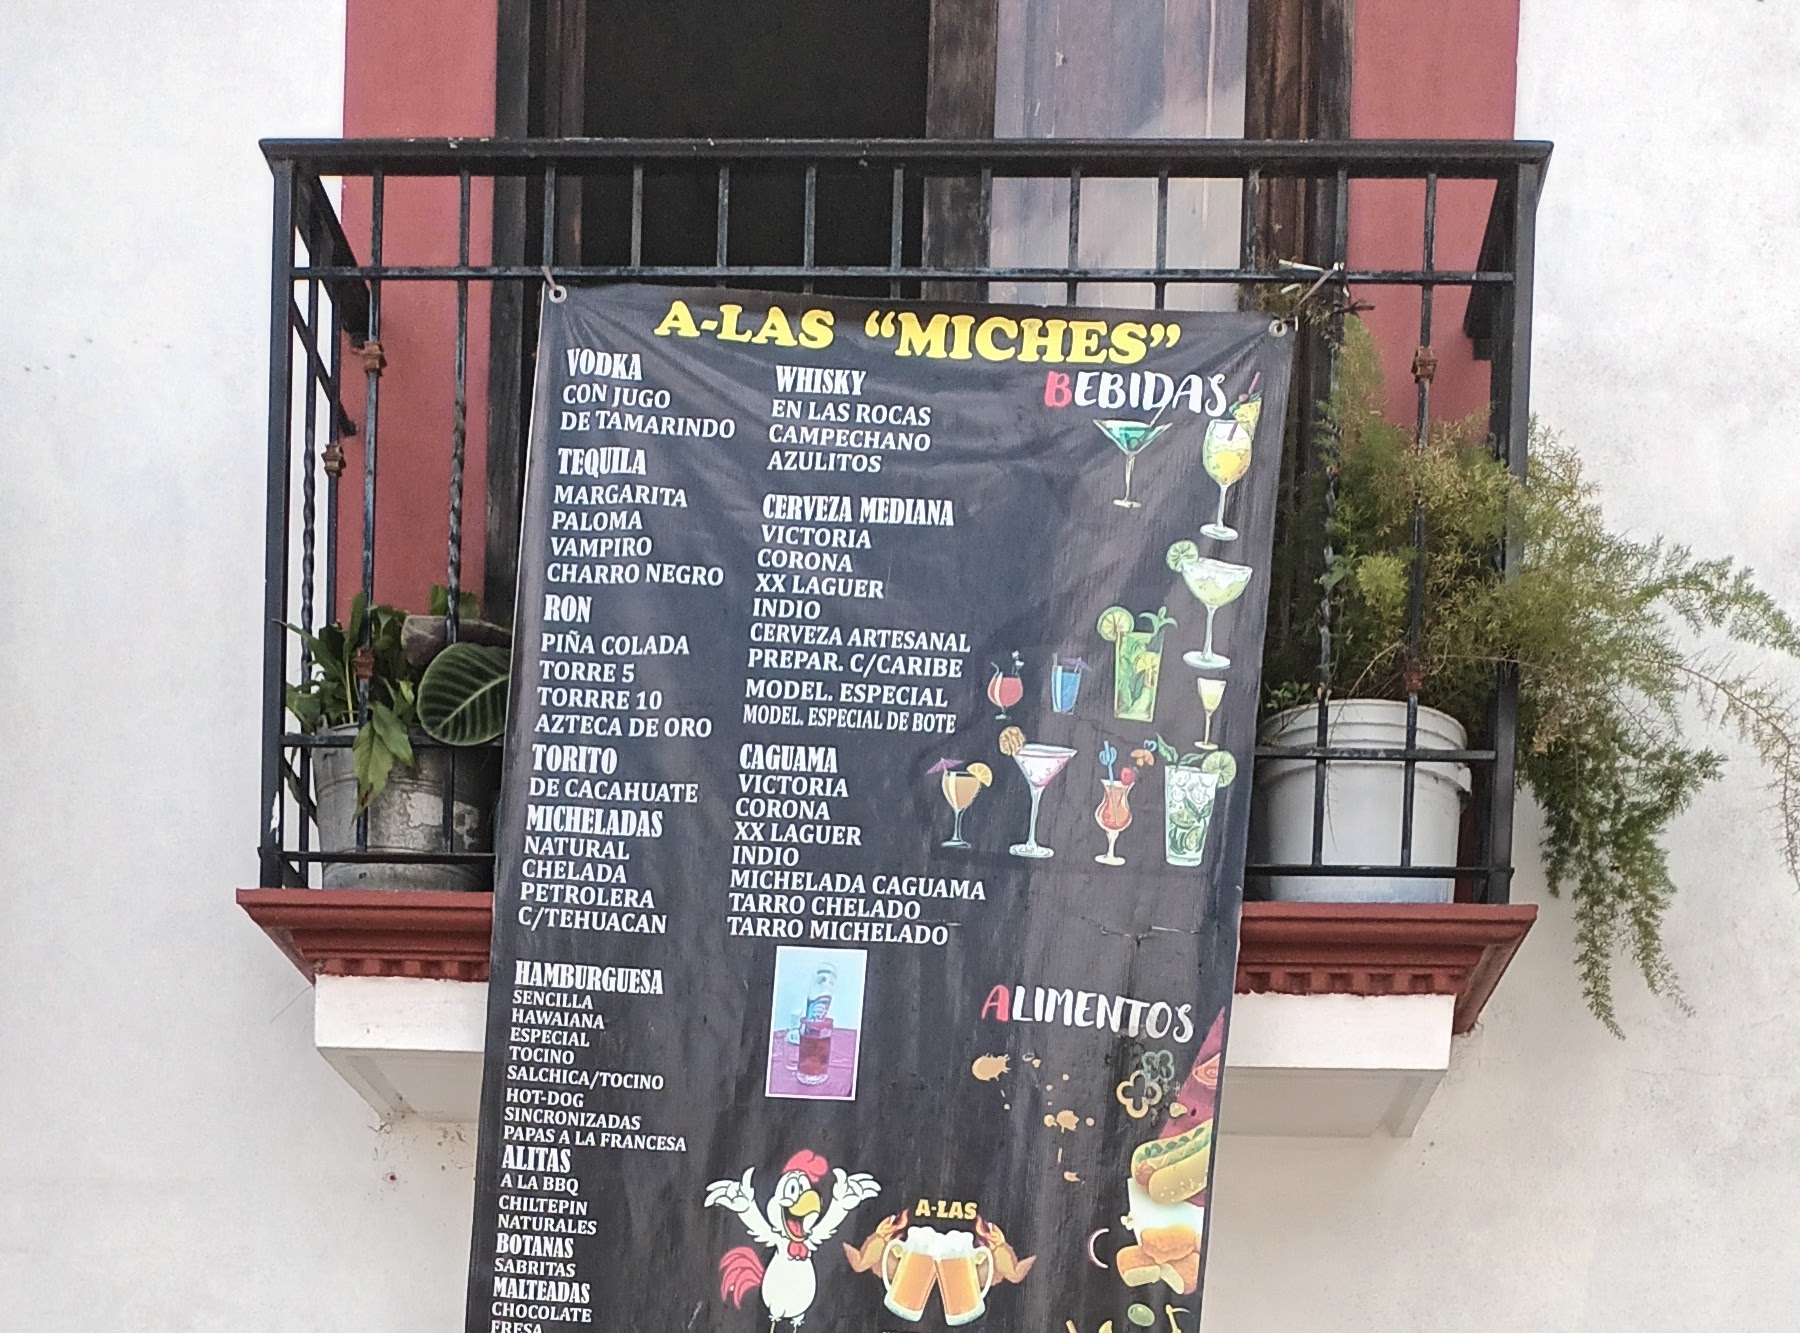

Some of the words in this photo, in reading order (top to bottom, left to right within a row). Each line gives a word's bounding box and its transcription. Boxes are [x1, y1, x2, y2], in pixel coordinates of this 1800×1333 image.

[653, 300, 835, 349] A-LAS
[566, 347, 643, 381] VODKA
[775, 364, 867, 396] WHISKY
[563, 383, 608, 404] CON
[611, 386, 671, 409] JUGO
[1044, 370, 1227, 418] BEBIDAS
[559, 411, 591, 431] DE
[595, 410, 736, 439] TAMARINDO
[771, 399, 803, 419] EN
[807, 401, 851, 423] LAS
[855, 403, 931, 427] ROCAS
[768, 423, 931, 452] CAMPECHANO
[557, 446, 647, 479] TEQUILA
[766, 450, 882, 473] AZULITOS
[553, 484, 688, 508] MARGARITA
[551, 510, 643, 532] PALOMA
[762, 493, 853, 523] CERVEZA
[859, 496, 954, 527] MEDIANA
[550, 536, 652, 558] VAMPIRO
[761, 523, 872, 549] VICTORIA
[757, 548, 854, 573] CORONA
[547, 562, 640, 585] CHARRO
[645, 563, 724, 586] NEGRO
[754, 573, 787, 593] XX
[791, 574, 884, 599] LAGUER
[543, 594, 593, 623] RON
[752, 597, 821, 620] INDIO
[540, 629, 595, 655] PIÑA
[601, 635, 690, 656] COLADA
[750, 622, 843, 646] CERVEZA
[846, 627, 971, 653] ARTESANAL
[538, 659, 617, 683] TORRE
[621, 663, 635, 684] 5
[747, 648, 844, 672] PREPAR.
[850, 653, 963, 679] C/CARIBE
[536, 686, 630, 710] TORRRE
[635, 690, 663, 711] 10
[745, 678, 833, 702] MODEL.
[839, 682, 948, 708] ESPECIAL
[533, 713, 623, 737] AZTECA
[628, 717, 660, 738] DE
[664, 717, 712, 738] ORO
[742, 703, 804, 726] MODEL.
[807, 706, 883, 730] ESPECIAL
[886, 710, 910, 732] DE
[911, 712, 957, 734] BOTE
[531, 743, 618, 775] TORITO
[739, 743, 838, 774] CAGUAMA
[528, 776, 560, 798] DE
[564, 778, 699, 803] CACAHUATE
[738, 773, 849, 798] VICTORIA
[525, 804, 663, 838] MICHELADAS
[735, 797, 831, 821] CORONA
[733, 820, 766, 842] XX
[770, 822, 862, 846] LAGUER
[523, 835, 630, 860] NATURAL
[731, 845, 799, 867] INDIO
[522, 858, 627, 884] CHELADA
[519, 881, 655, 909] PETROLERA
[729, 868, 866, 894] MICHELADA
[872, 875, 986, 901] CAGUAMA
[728, 892, 806, 915] TARRO
[811, 896, 921, 920] CHELADO
[518, 906, 668, 934] C/TEHUACAN
[726, 916, 804, 938] TARRO
[809, 919, 949, 946] MICHELADO
[514, 959, 664, 995] HAMBURGUESA
[512, 989, 594, 1010] SENCILLA
[511, 1007, 605, 1030] HAWAIANA
[981, 984, 1194, 1043] ALIMENTOS
[509, 1026, 590, 1048] ESPECIAL
[508, 1045, 575, 1065] TOCINO
[506, 1064, 664, 1090] SALCHICA/TOCINO
[505, 1087, 584, 1108] HOT-DOG
[504, 1106, 642, 1131] SINCRONIZADAS
[503, 1124, 556, 1143] PAPAS
[557, 1129, 571, 1145] A
[574, 1130, 596, 1147] LA
[599, 1132, 687, 1152] FRANCESA
[501, 1144, 571, 1174] ALITAS
[500, 1172, 513, 1188] A
[516, 1174, 539, 1191] LA
[542, 1176, 579, 1197] BBQ
[498, 1194, 588, 1216] CHILTEPIN
[915, 1198, 978, 1220] A-LAS
[498, 1213, 598, 1236] NATURALES
[495, 1232, 574, 1259] BOTANAS
[494, 1257, 576, 1278] SABRITAS
[492, 1276, 591, 1304] MALTEADAS
[491, 1301, 593, 1323] CHOCOLATE
